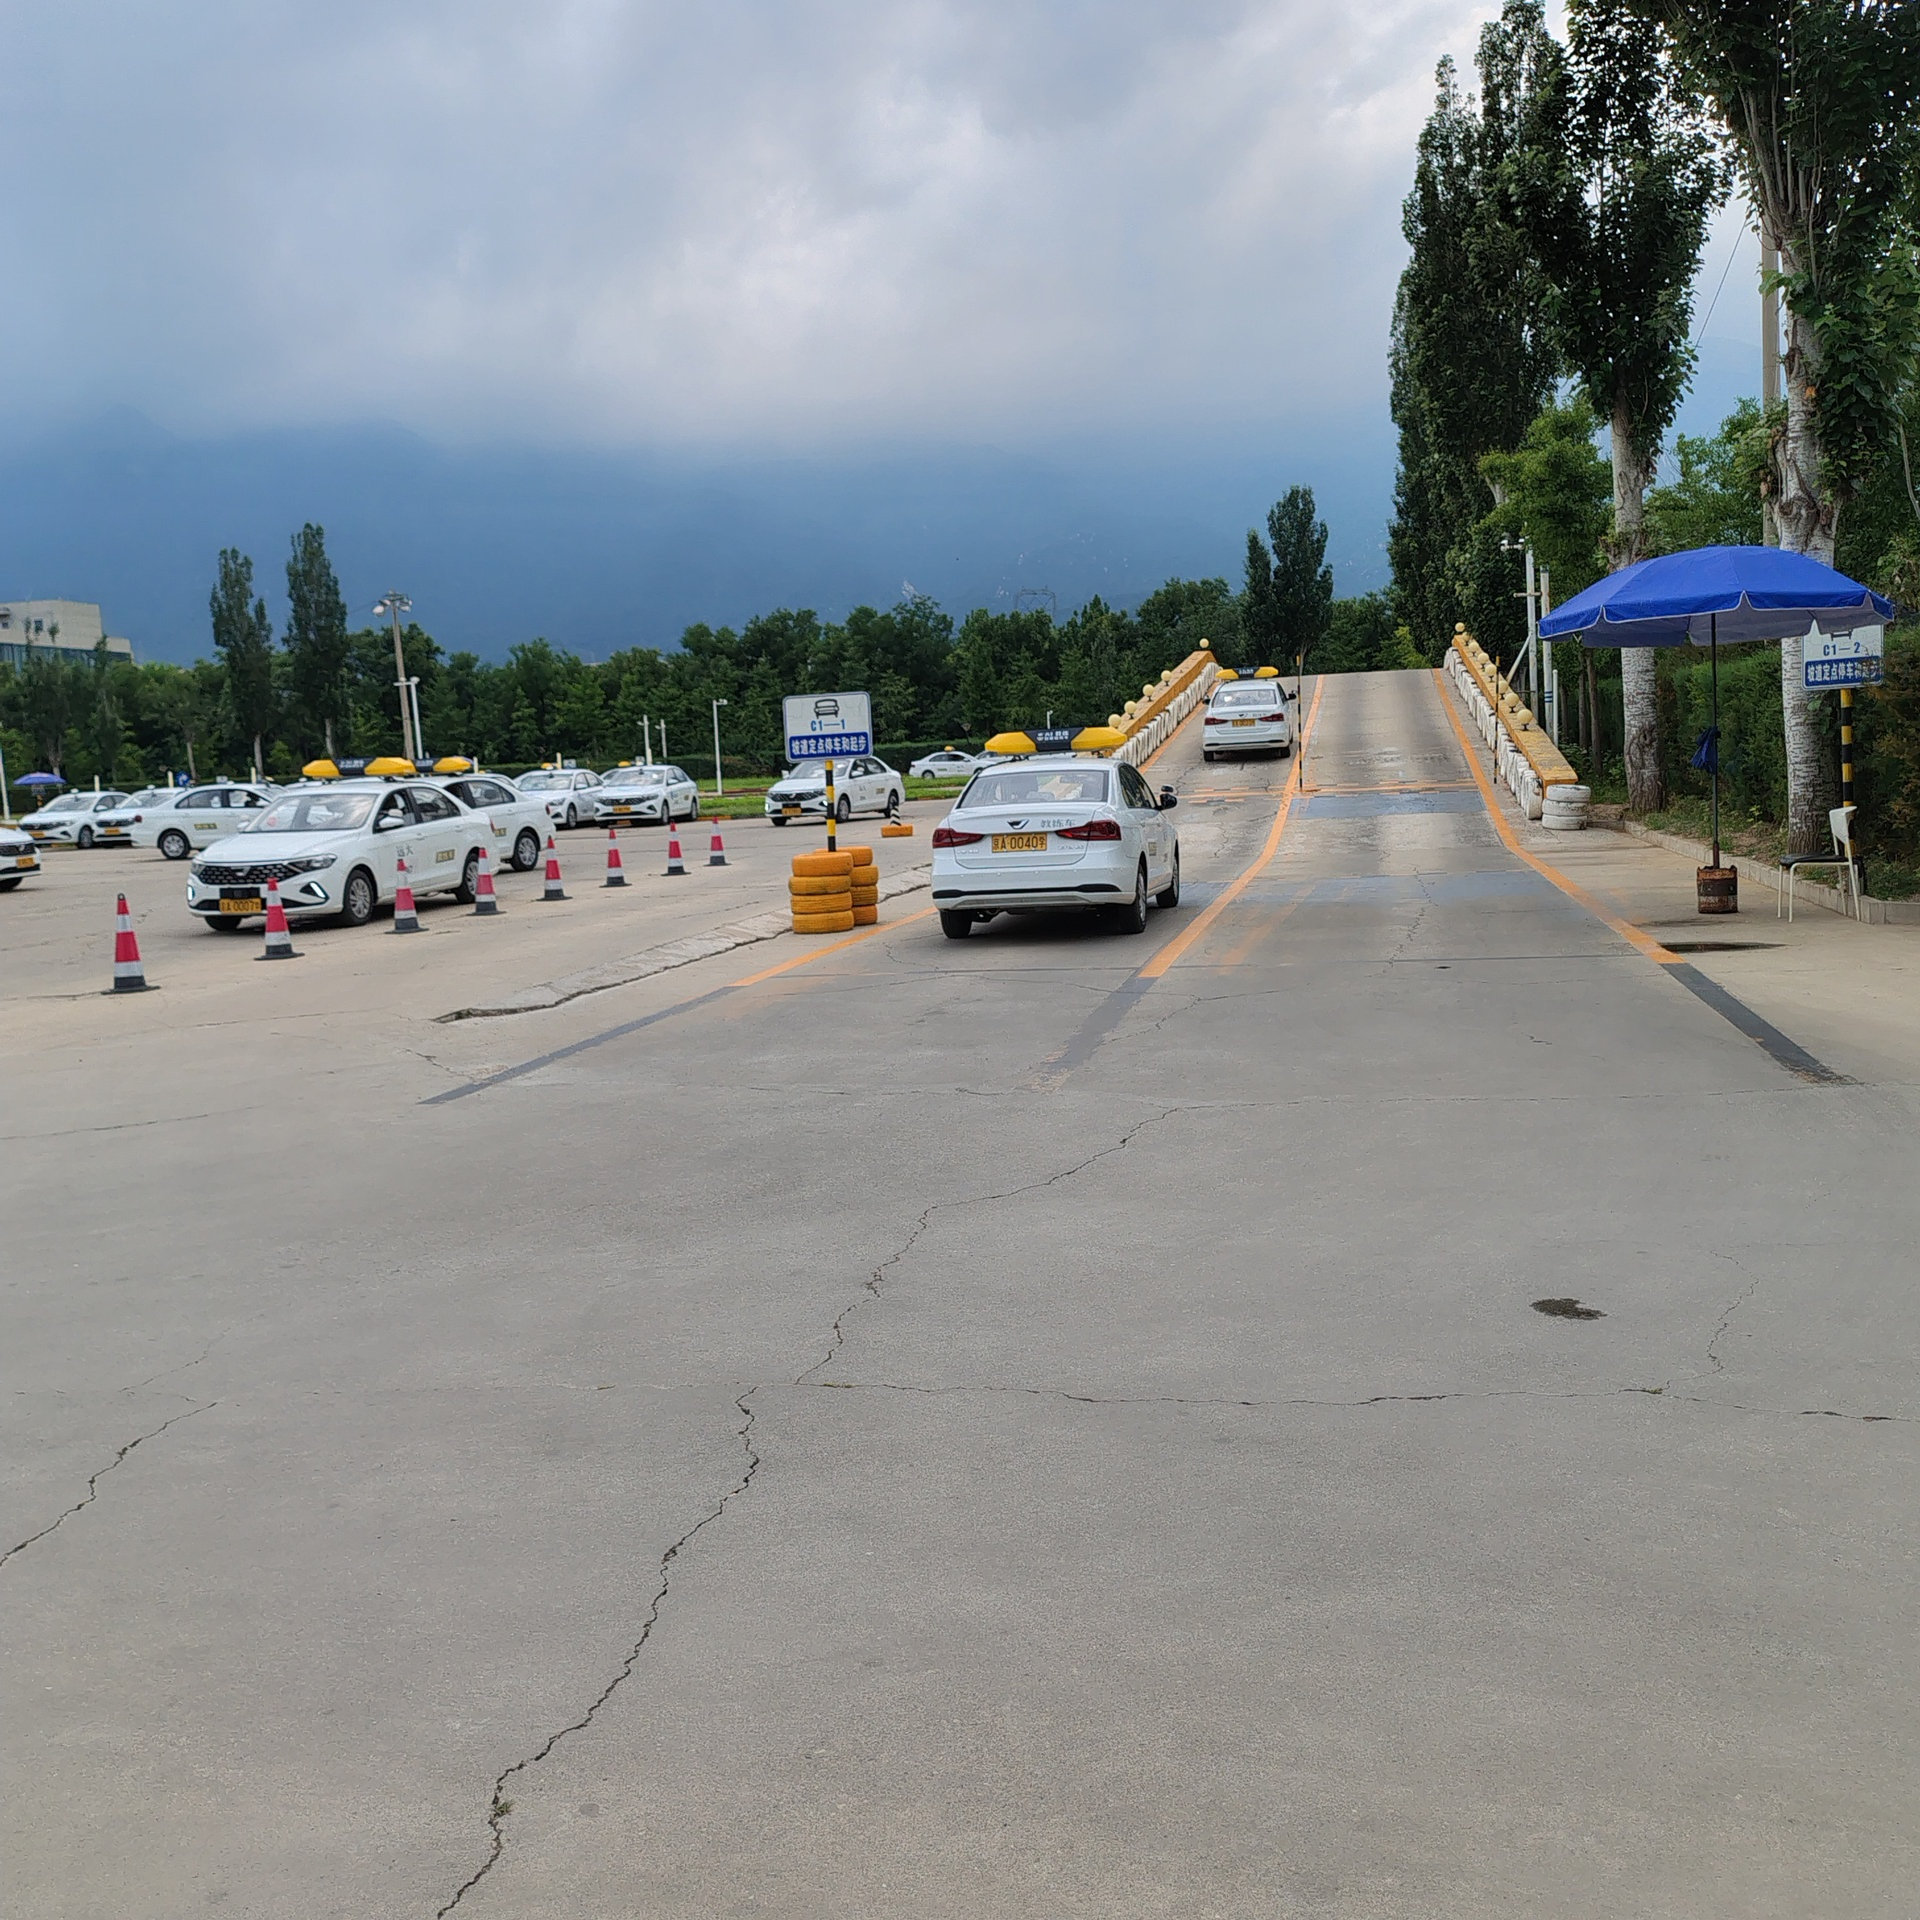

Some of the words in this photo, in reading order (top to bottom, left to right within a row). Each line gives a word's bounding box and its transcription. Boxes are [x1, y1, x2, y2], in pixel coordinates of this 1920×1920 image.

[791, 735, 867, 756] 坡道定点停车和起步
